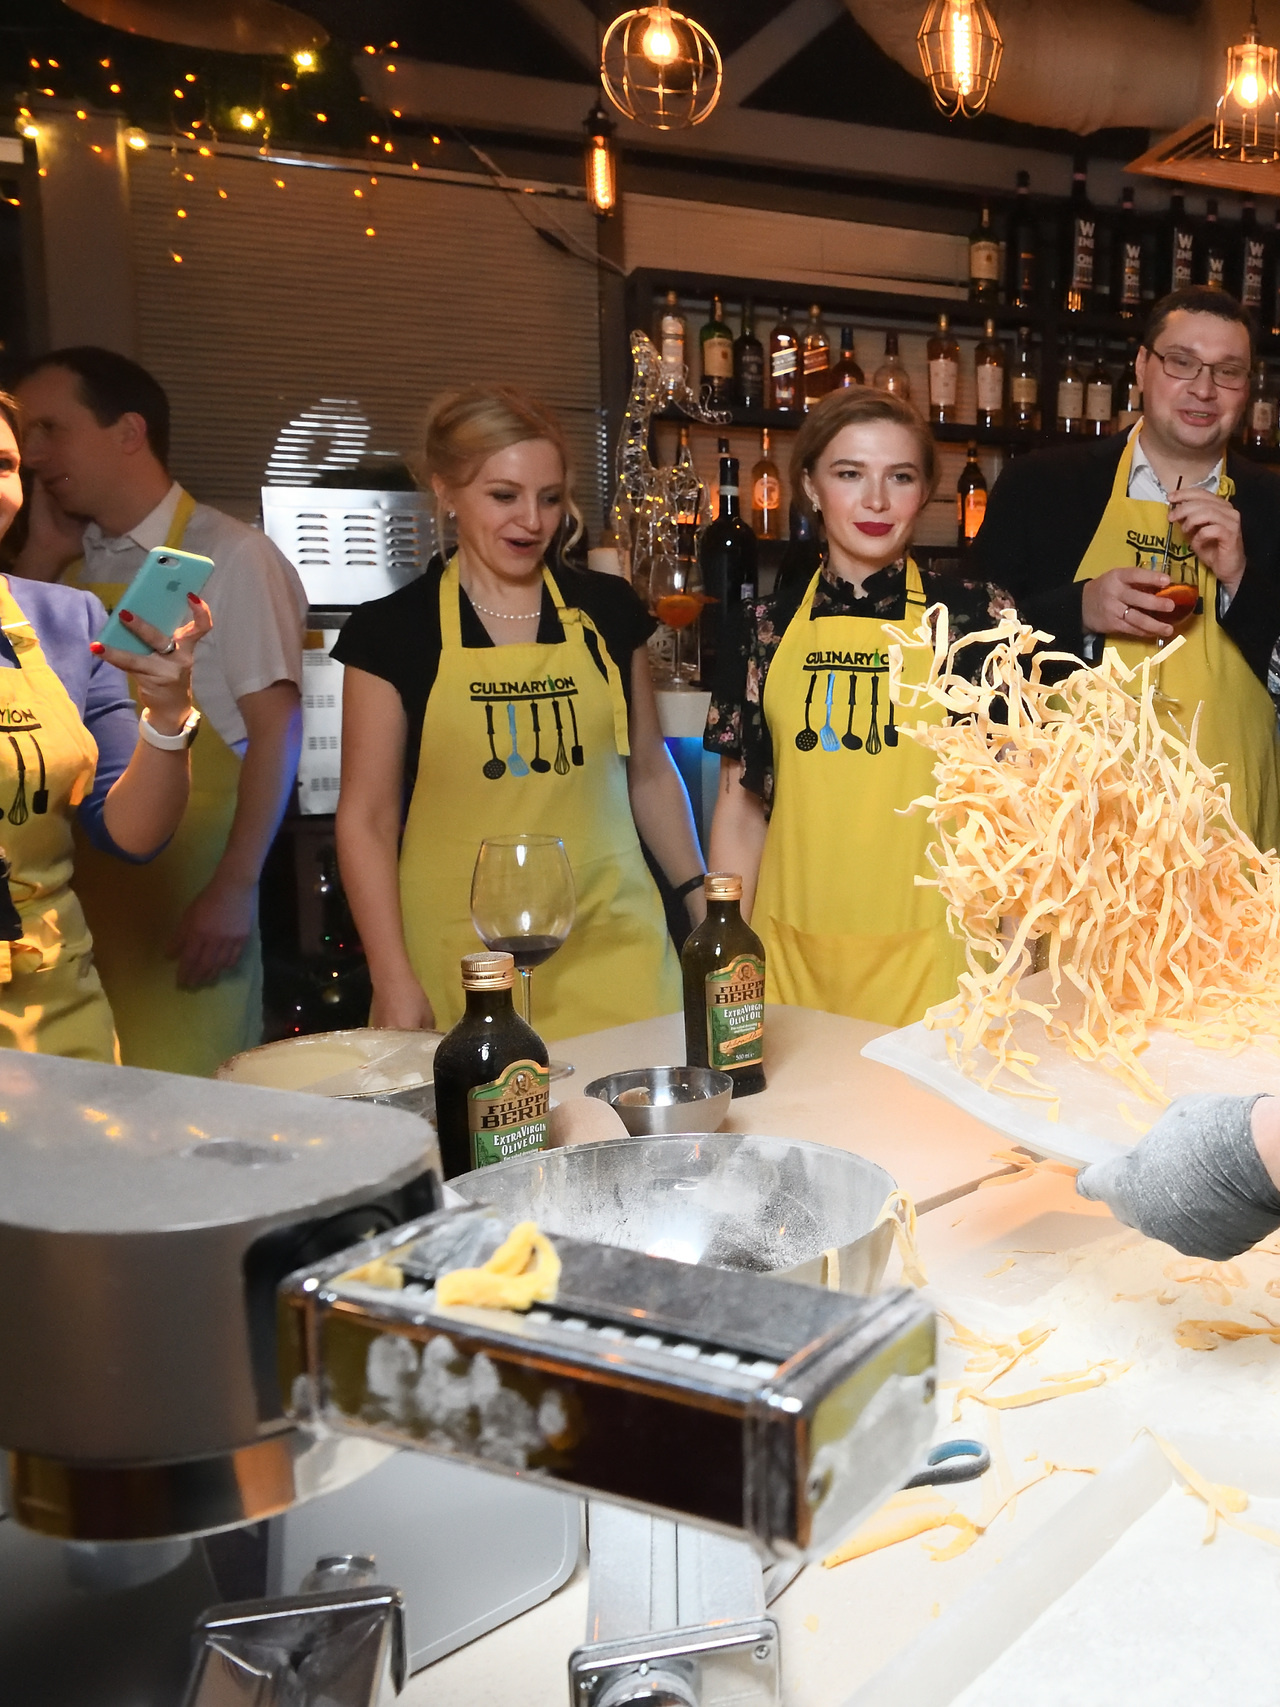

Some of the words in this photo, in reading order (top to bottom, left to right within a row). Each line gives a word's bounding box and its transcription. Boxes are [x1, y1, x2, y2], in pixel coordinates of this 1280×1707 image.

[1127, 530, 1182, 555] CULINRY
[806, 651, 874, 665] CULINARY
[470, 680, 547, 694] CULINARY
[554, 676, 576, 689] ON
[729, 1013, 749, 1026] OLIVE
[750, 1011, 761, 1020] OIL
[494, 1131, 522, 1146] EXTRA
[501, 1138, 528, 1156] OLIVE
[529, 1133, 543, 1146] OIL
